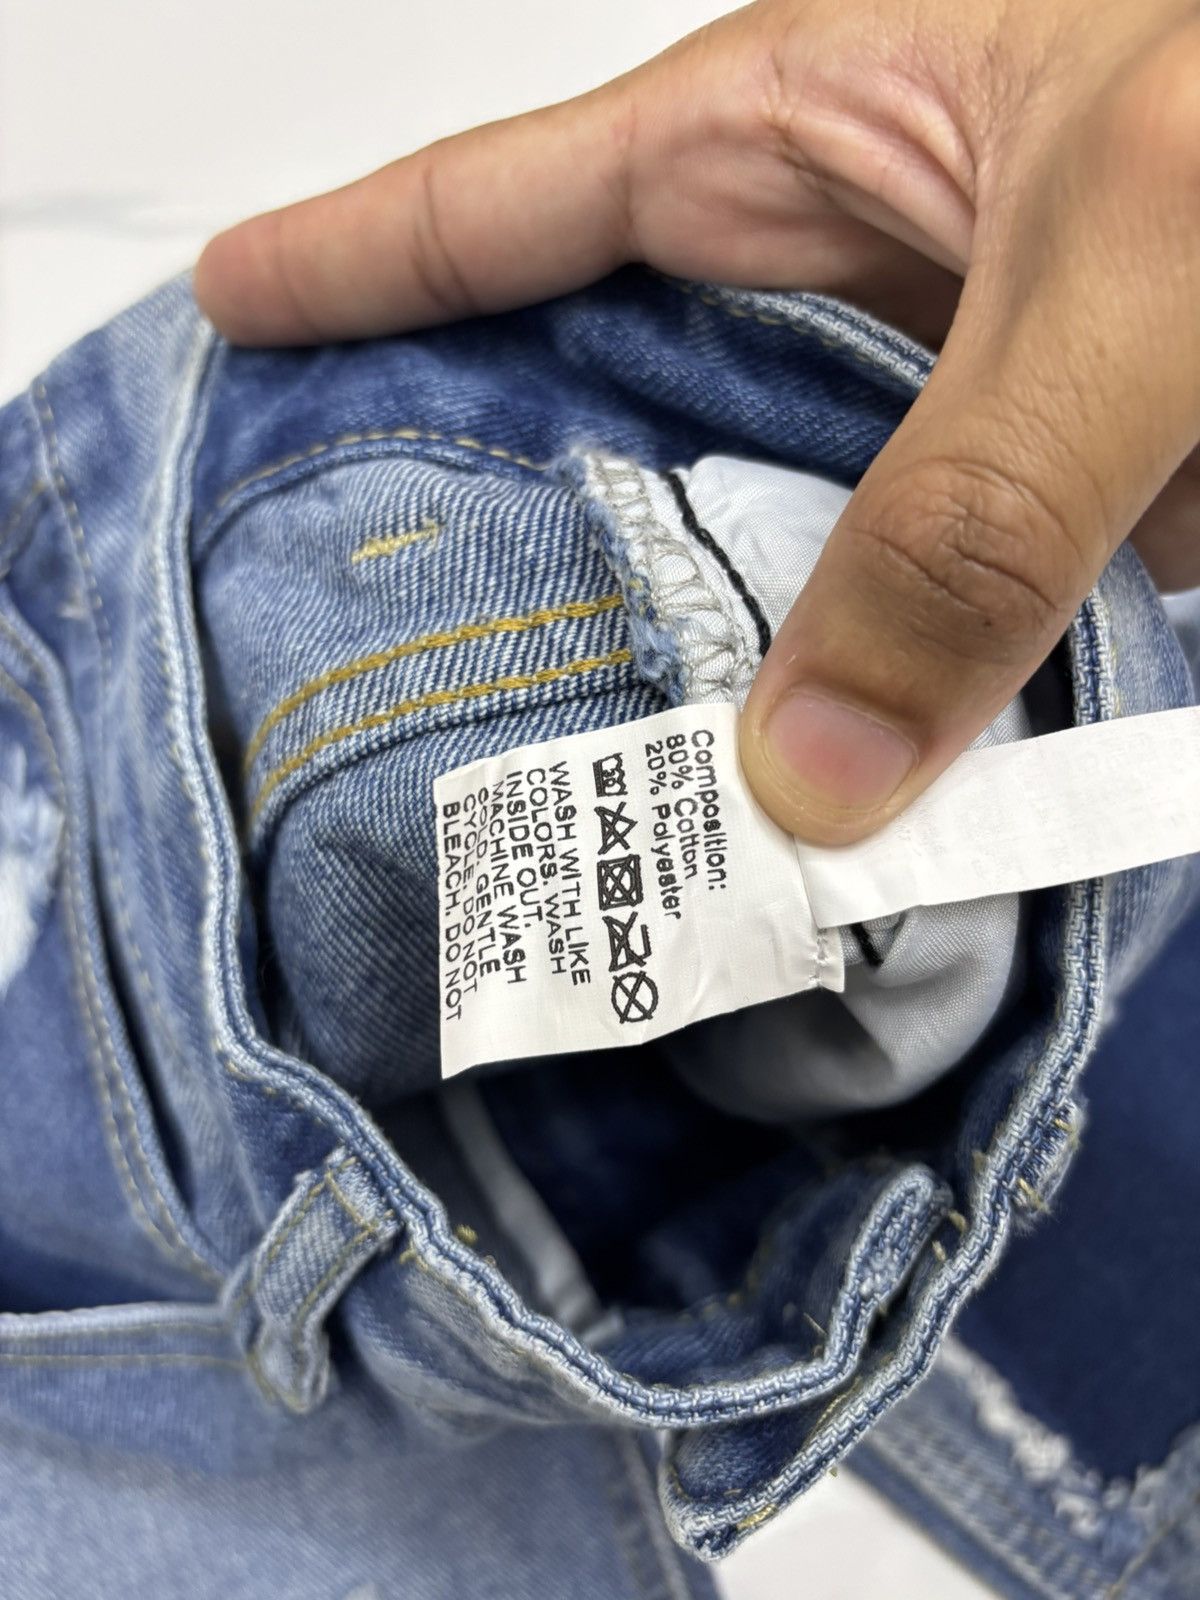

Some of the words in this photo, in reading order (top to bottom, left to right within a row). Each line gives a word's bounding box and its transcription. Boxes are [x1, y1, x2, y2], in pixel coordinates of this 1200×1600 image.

[602, 768, 616, 787] 30
[645, 740, 668, 795] 20%
[667, 734, 693, 789] 80%
[476, 787, 489, 866] COLD.
[489, 780, 514, 899] MACHINE
[505, 771, 533, 860] INSIDE
[549, 761, 577, 842] WASH
[675, 800, 697, 879] Cotton
[692, 730, 727, 891] Composition:
[443, 801, 462, 916] BLEACH.
[464, 793, 477, 889] CYCLE.
[527, 768, 558, 886] COLORS.
[544, 893, 567, 974] WASH
[652, 805, 681, 919] Polyester
[463, 897, 475, 935] DO
[517, 867, 542, 928] OUT.
[560, 848, 582, 918] WITH
[445, 923, 461, 962] DO
[475, 873, 501, 977] GENTLE
[498, 906, 527, 984] WASH
[566, 926, 592, 986] LIKE
[445, 968, 462, 1020] NOT
[463, 940, 478, 993] NOT
